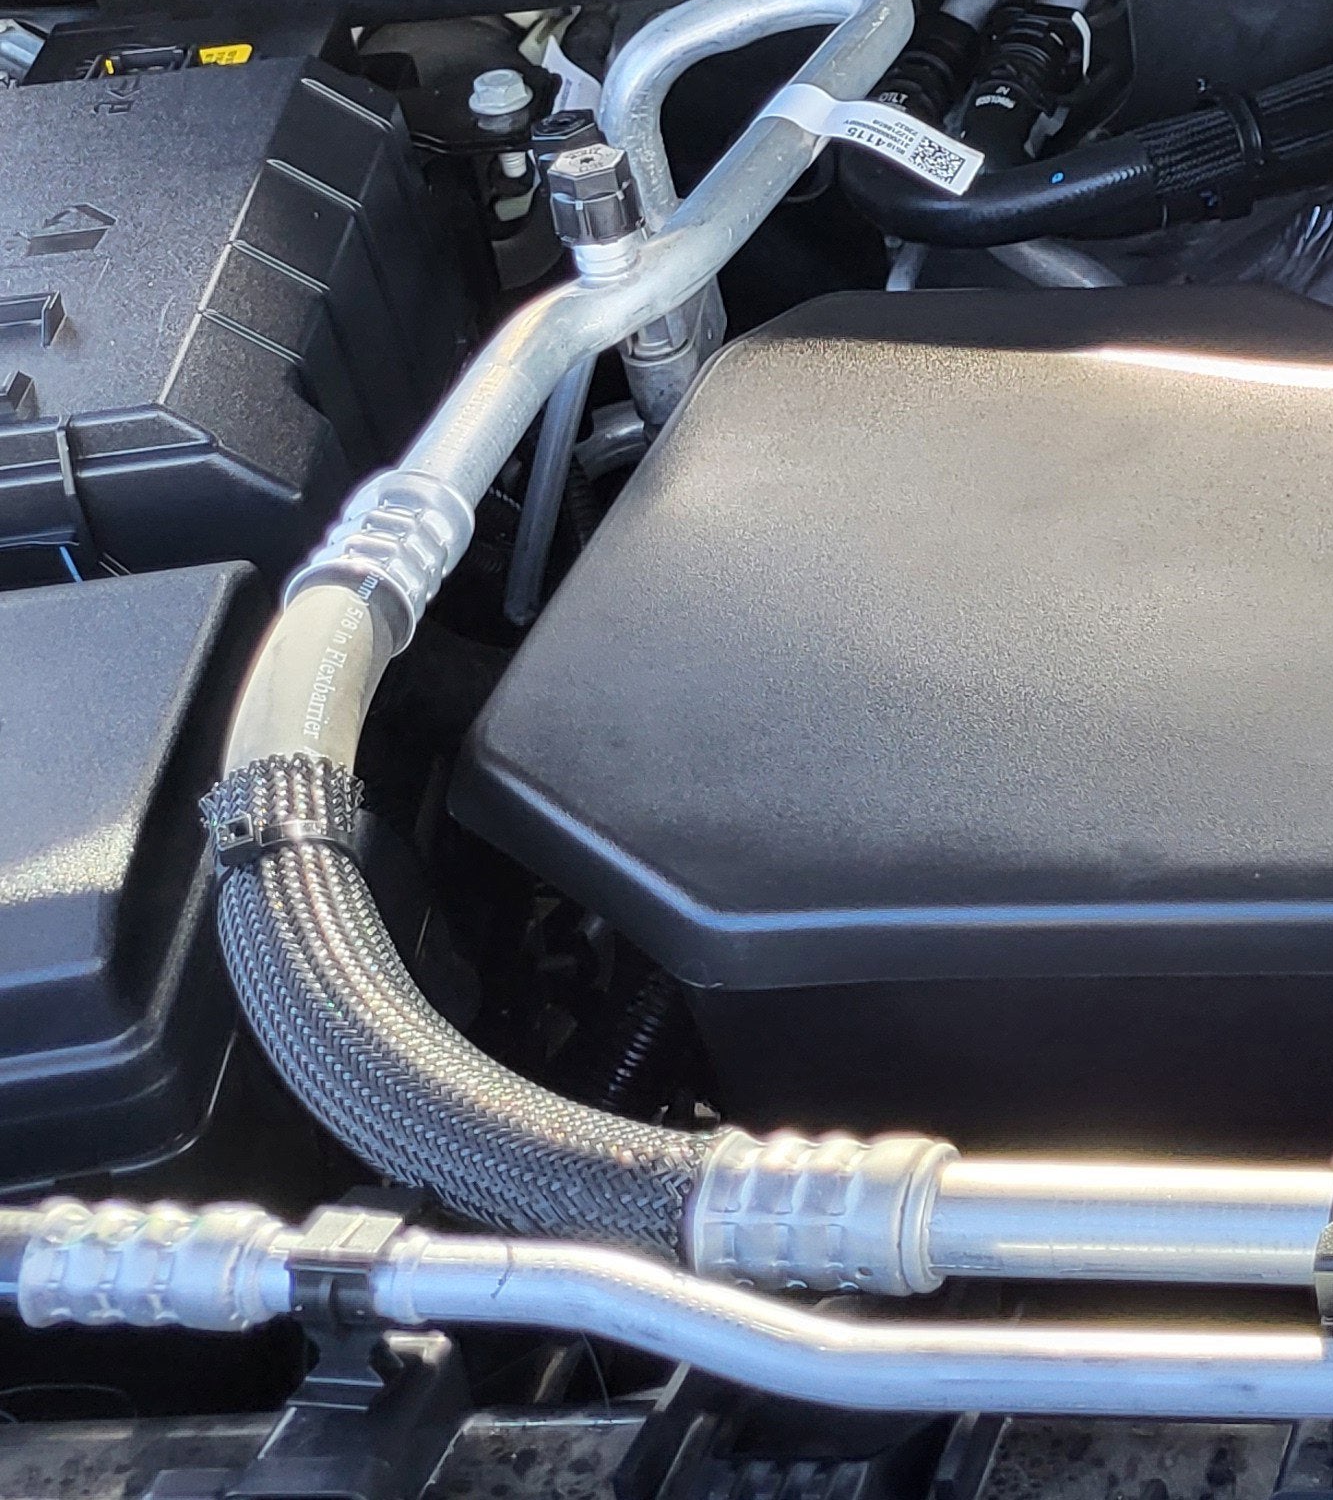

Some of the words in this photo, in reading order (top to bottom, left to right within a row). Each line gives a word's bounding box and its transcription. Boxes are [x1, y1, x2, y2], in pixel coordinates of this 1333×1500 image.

[846, 126, 887, 148] 4115
[339, 606, 365, 631] 5/8
[333, 628, 353, 645] in
